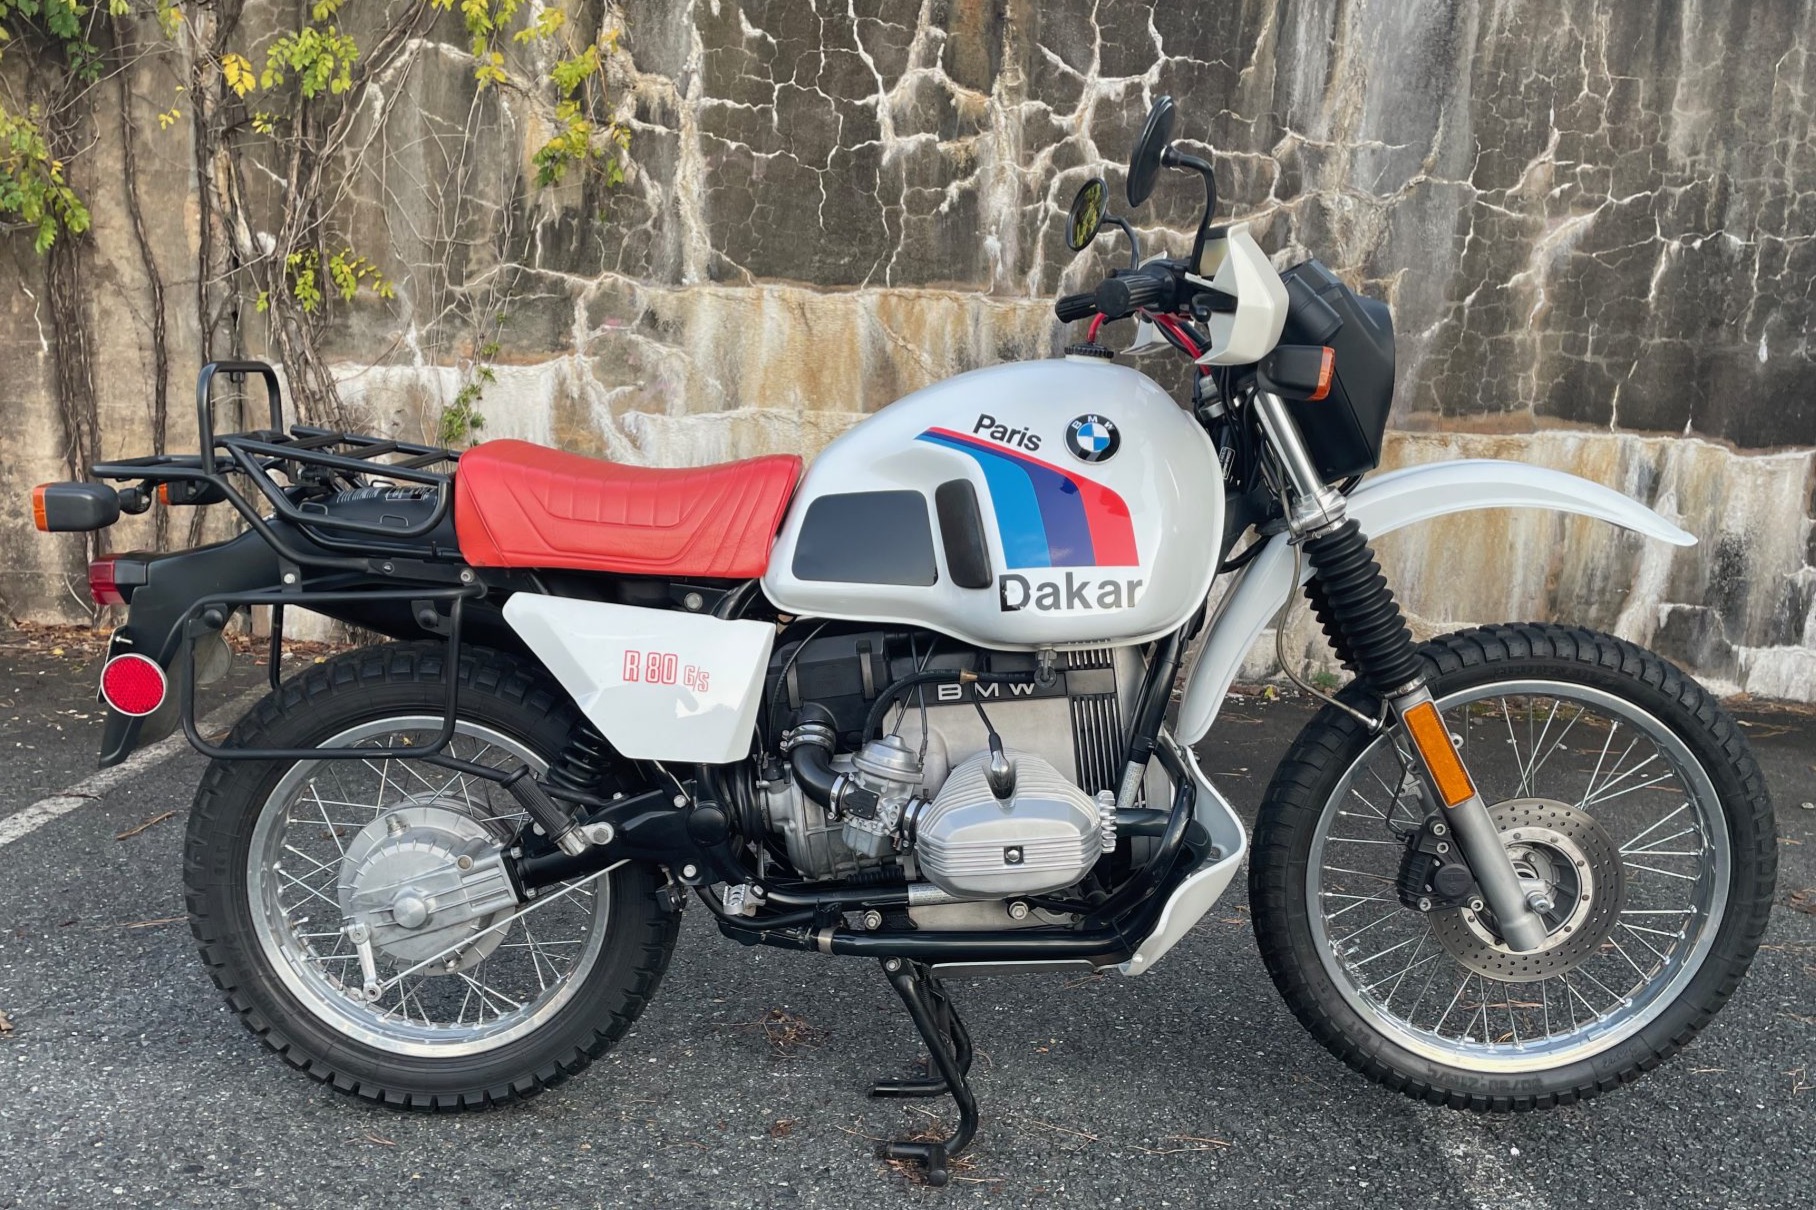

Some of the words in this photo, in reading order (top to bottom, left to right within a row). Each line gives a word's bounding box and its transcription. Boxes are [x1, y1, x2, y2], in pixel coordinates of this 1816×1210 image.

[972, 413, 1042, 452] Paris
[1071, 415, 1115, 430] BMW
[999, 571, 1143, 612] Dakar
[623, 650, 640, 682] R
[645, 652, 678, 685] 80
[683, 664, 710, 692] G/S
[938, 682, 1035, 700] BMW
